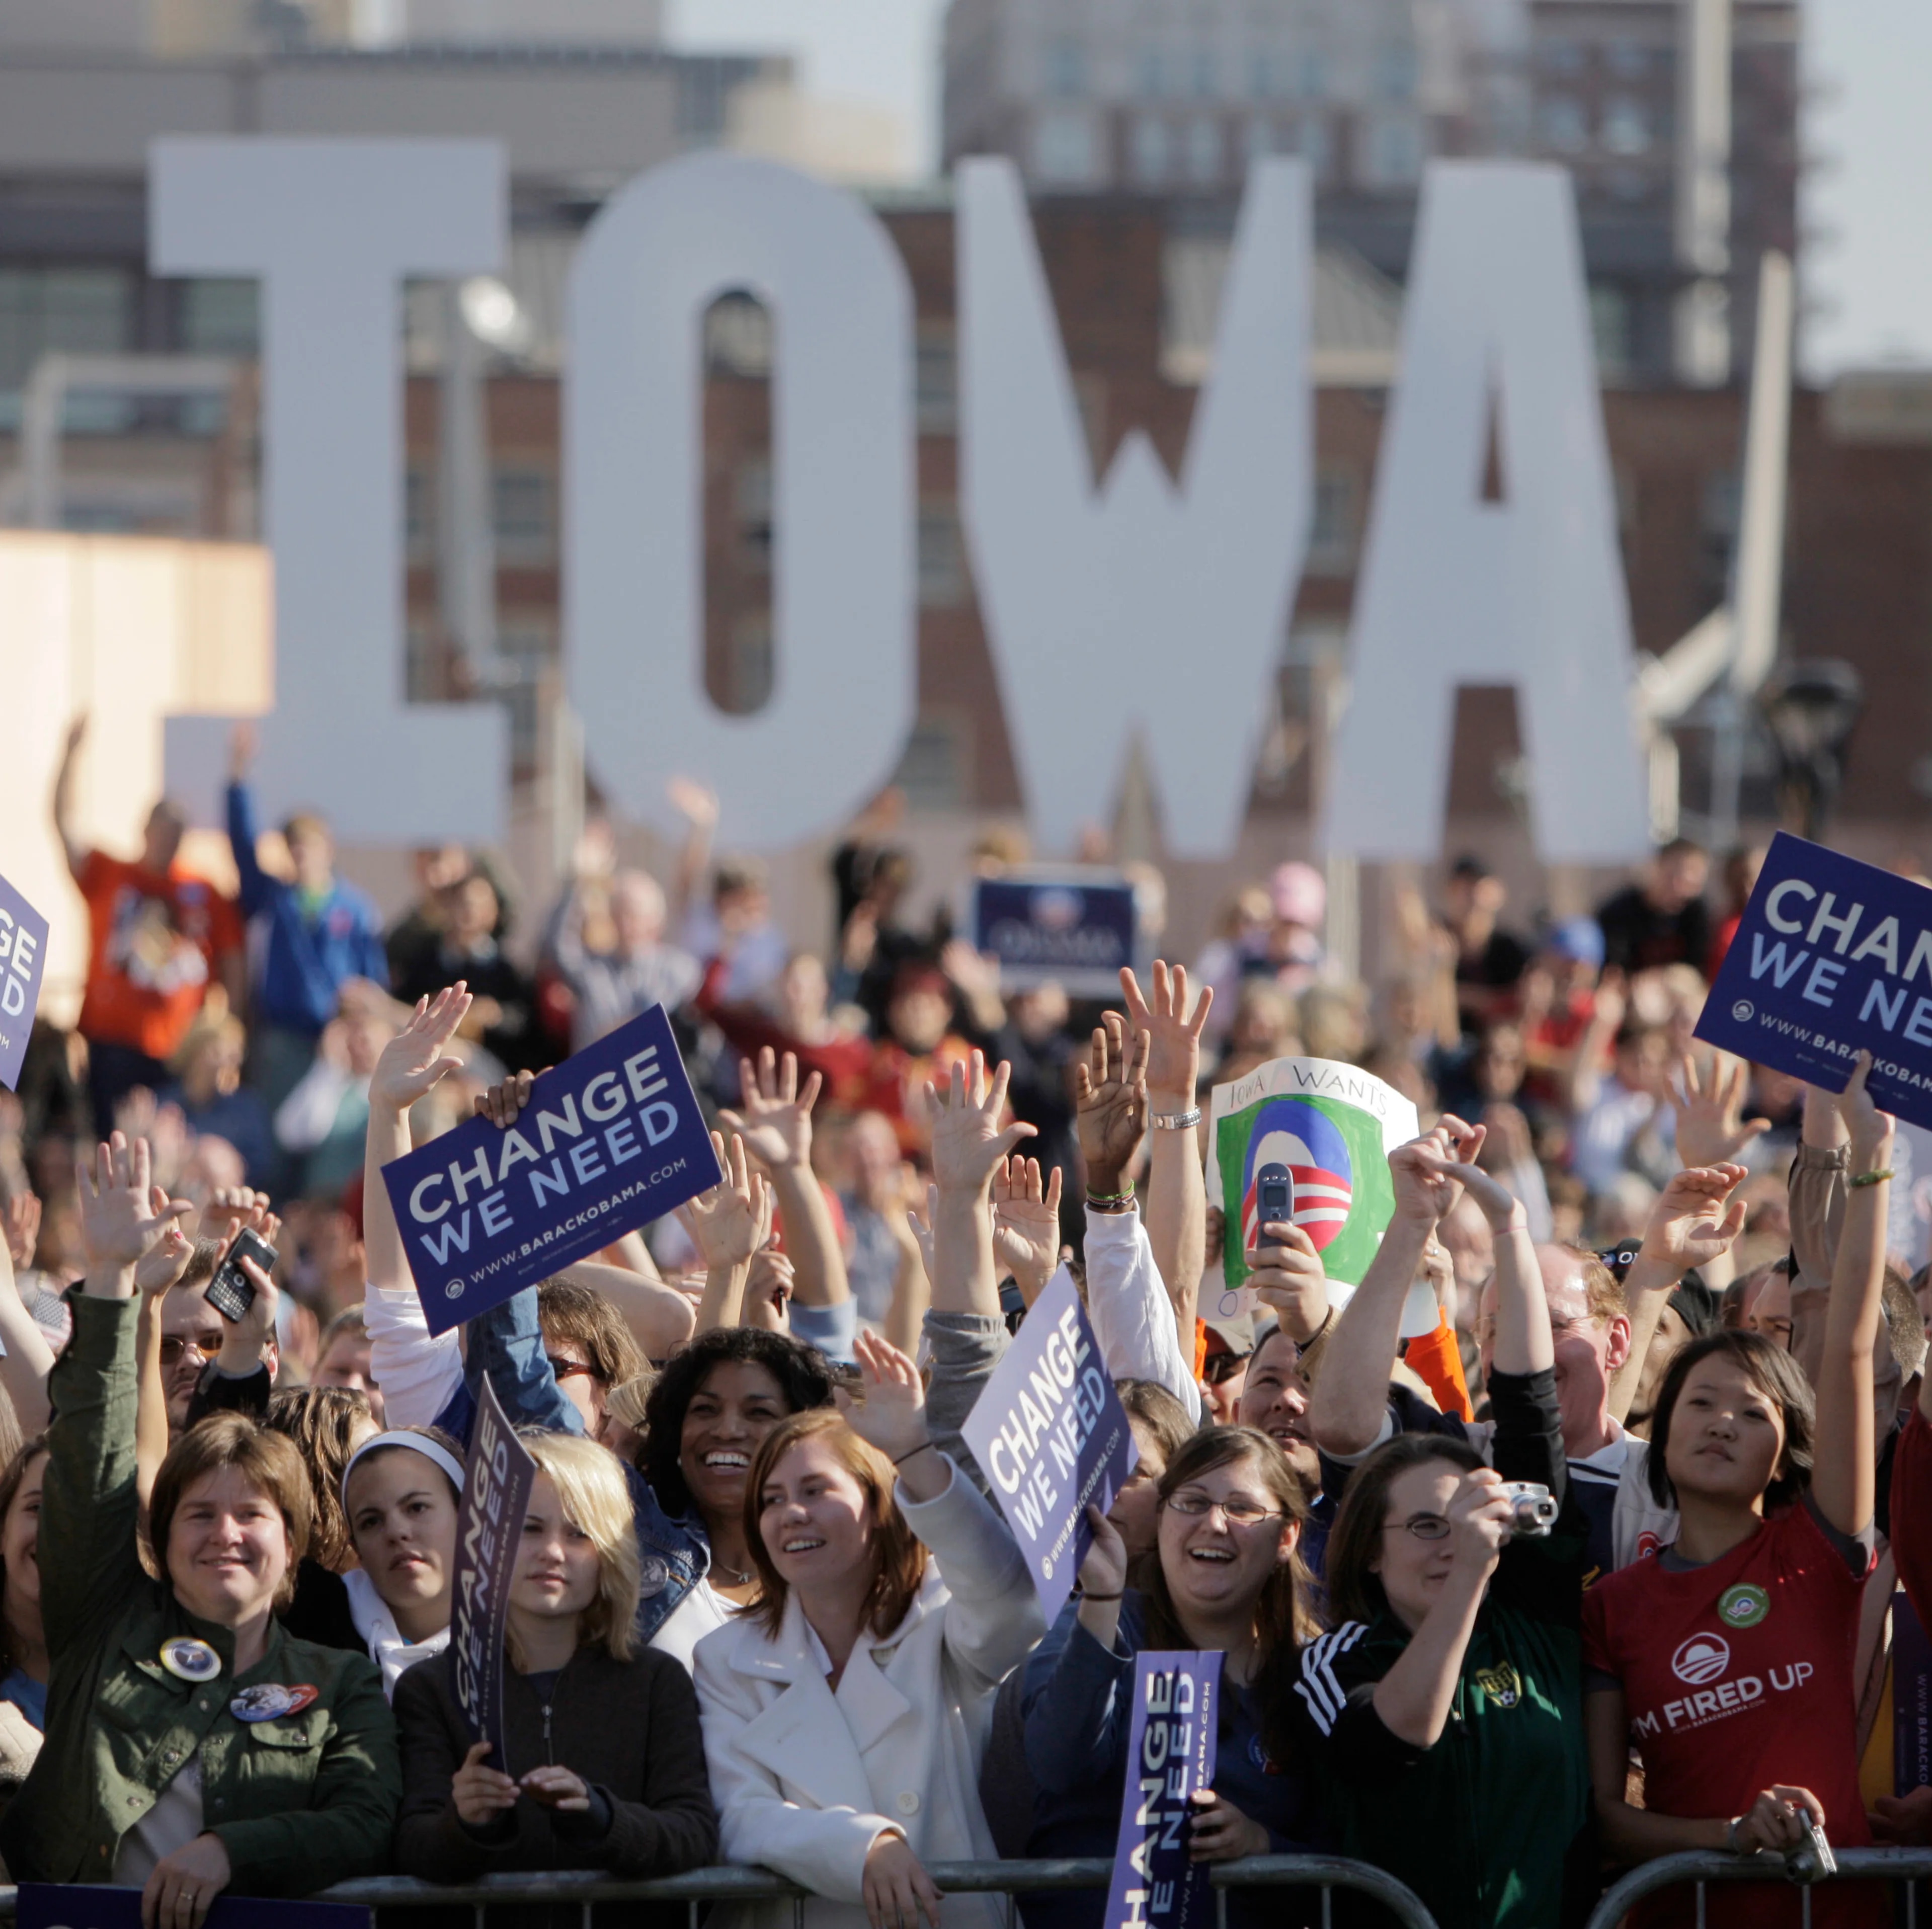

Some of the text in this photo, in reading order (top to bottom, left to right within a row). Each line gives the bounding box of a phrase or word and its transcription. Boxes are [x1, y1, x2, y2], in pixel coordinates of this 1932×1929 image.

[148, 136, 1650, 859] IOWA
[1750, 932, 1932, 1048] WE NE
[1760, 1013, 1932, 1092] WWW.BARAKOBAM
[409, 1045, 668, 1224] CHANGE
[1231, 1065, 1387, 1116] IOWA WANTS
[420, 1190, 514, 1266] WE
[528, 1100, 679, 1208] NEED
[470, 1157, 687, 1284] WWW.BARACKOBAMA.COM
[990, 1305, 1091, 1495] CHANGE
[1014, 1461, 1058, 1542] WE
[1050, 1367, 1106, 1481] NEED
[457, 1407, 498, 1709] CHANGE
[469, 1439, 509, 1727] WE NEED
[1160, 1673, 1194, 1850] NEED
[1663, 1676, 1763, 1728] FIRED
[1768, 1662, 1814, 1691] UP
